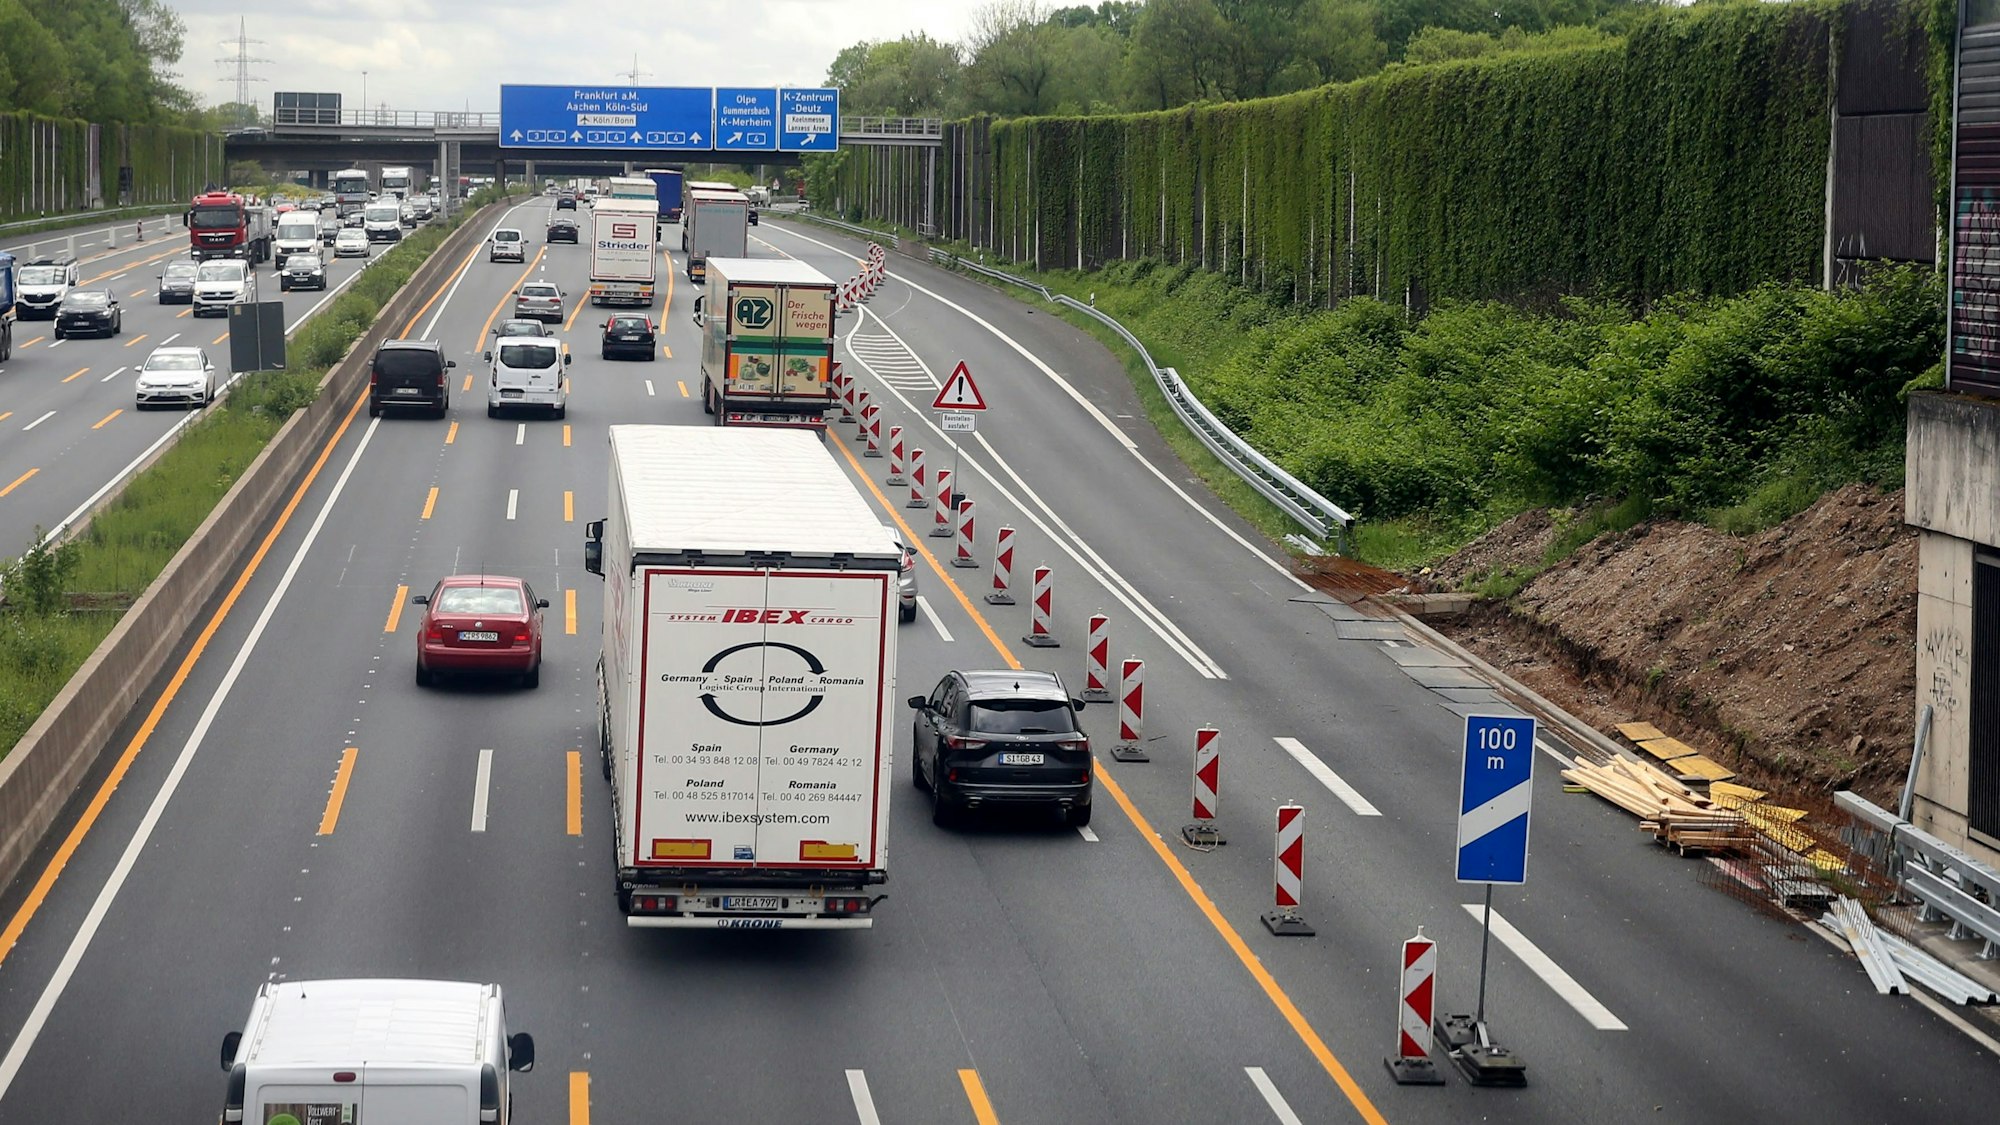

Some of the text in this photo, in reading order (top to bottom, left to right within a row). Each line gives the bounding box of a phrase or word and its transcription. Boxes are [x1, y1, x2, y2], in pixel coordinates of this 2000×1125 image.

[574, 90, 640, 101] Frankfurt a.M.
[736, 94, 757, 105] Olpe
[783, 92, 834, 102] K-Zentrum
[566, 102, 648, 112] Aachen Köln-Süd
[722, 106, 770, 115] Gummersbach
[791, 104, 822, 113] -Deutz
[592, 115, 634, 125] Köln/Bonn
[720, 117, 772, 126] K-Merheim
[533, 132, 560, 141] 3 4
[593, 133, 620, 142] 3 4
[652, 134, 680, 143] 3 4
[753, 135, 760, 143] 4
[598, 240, 649, 250] Strieder
[787, 300, 805, 309] Der
[736, 298, 770, 325] AZ
[791, 310, 824, 320] Frische
[795, 321, 828, 331] wegen
[668, 614, 717, 622] SYSTEM
[721, 609, 811, 625] IBEX
[661, 673, 709, 685] Germany
[723, 674, 753, 686] Spain
[768, 675, 804, 685] Poland
[819, 676, 865, 686] Romania
[699, 683, 827, 693] Logistic Group International
[1478, 727, 1516, 750] 100
[691, 743, 722, 754] Spain
[789, 744, 840, 756] Germany
[653, 755, 758, 766] Tel. 00 34 93 848 12 08
[765, 756, 863, 767] Tel. 00 49 7824 42 12
[1031, 754, 1041, 763] 43
[1487, 756, 1505, 770] m
[685, 779, 725, 788] Poland
[788, 780, 837, 790] Romania
[653, 790, 755, 801] Tel. 00 48 525 817014
[762, 792, 862, 803] Tel. 00 40 269 844447
[685, 811, 831, 826] www.ibexsystem.com
[729, 897, 777, 907] LR EA 797
[730, 919, 784, 929] KRONE
[307, 1104, 340, 1117] VOLLWERT-
